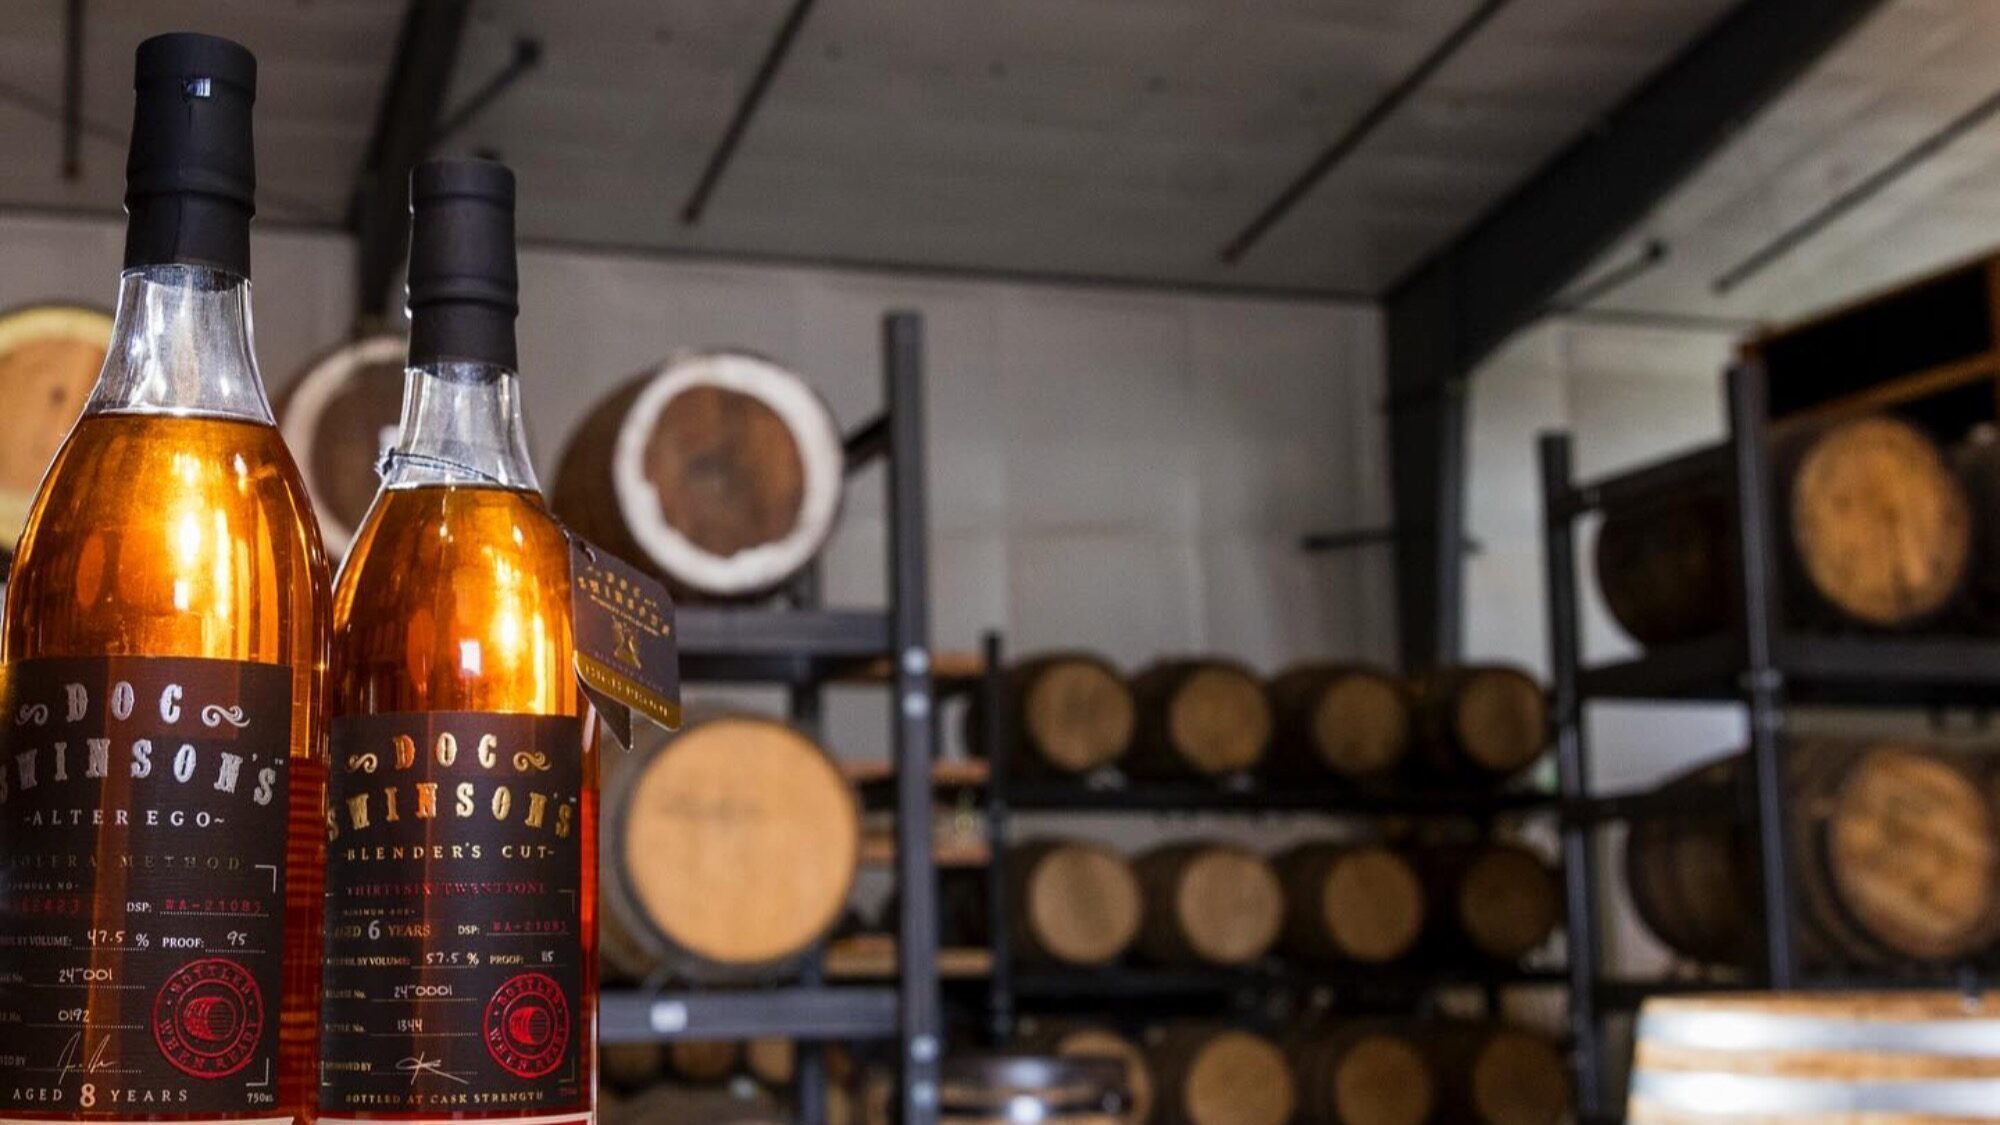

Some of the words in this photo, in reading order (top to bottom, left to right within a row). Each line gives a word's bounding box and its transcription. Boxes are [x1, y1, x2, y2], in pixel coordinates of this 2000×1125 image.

[66, 680, 184, 724] DOC
[393, 731, 498, 771] DOC
[126, 902, 152, 914] DSP:
[367, 919, 382, 940] 6
[387, 923, 432, 938] YEARS
[86, 928, 127, 947] 47.5
[135, 932, 150, 949] %
[162, 937, 206, 949] PROOF:
[226, 930, 248, 947] 95
[425, 951, 461, 965] 57.5
[466, 951, 480, 967] %
[489, 954, 524, 966] PROOF:
[57, 1008, 91, 1023] 0192
[397, 1018, 423, 1032] 1344
[13, 1088, 63, 1101] AGED
[79, 1083, 97, 1108] 8
[110, 1088, 188, 1102] YEARS
[346, 1093, 401, 1104] BOTTLED
[406, 1093, 424, 1104] AT
[430, 1092, 468, 1104] CASK
[474, 1091, 544, 1104] STRENGTH
